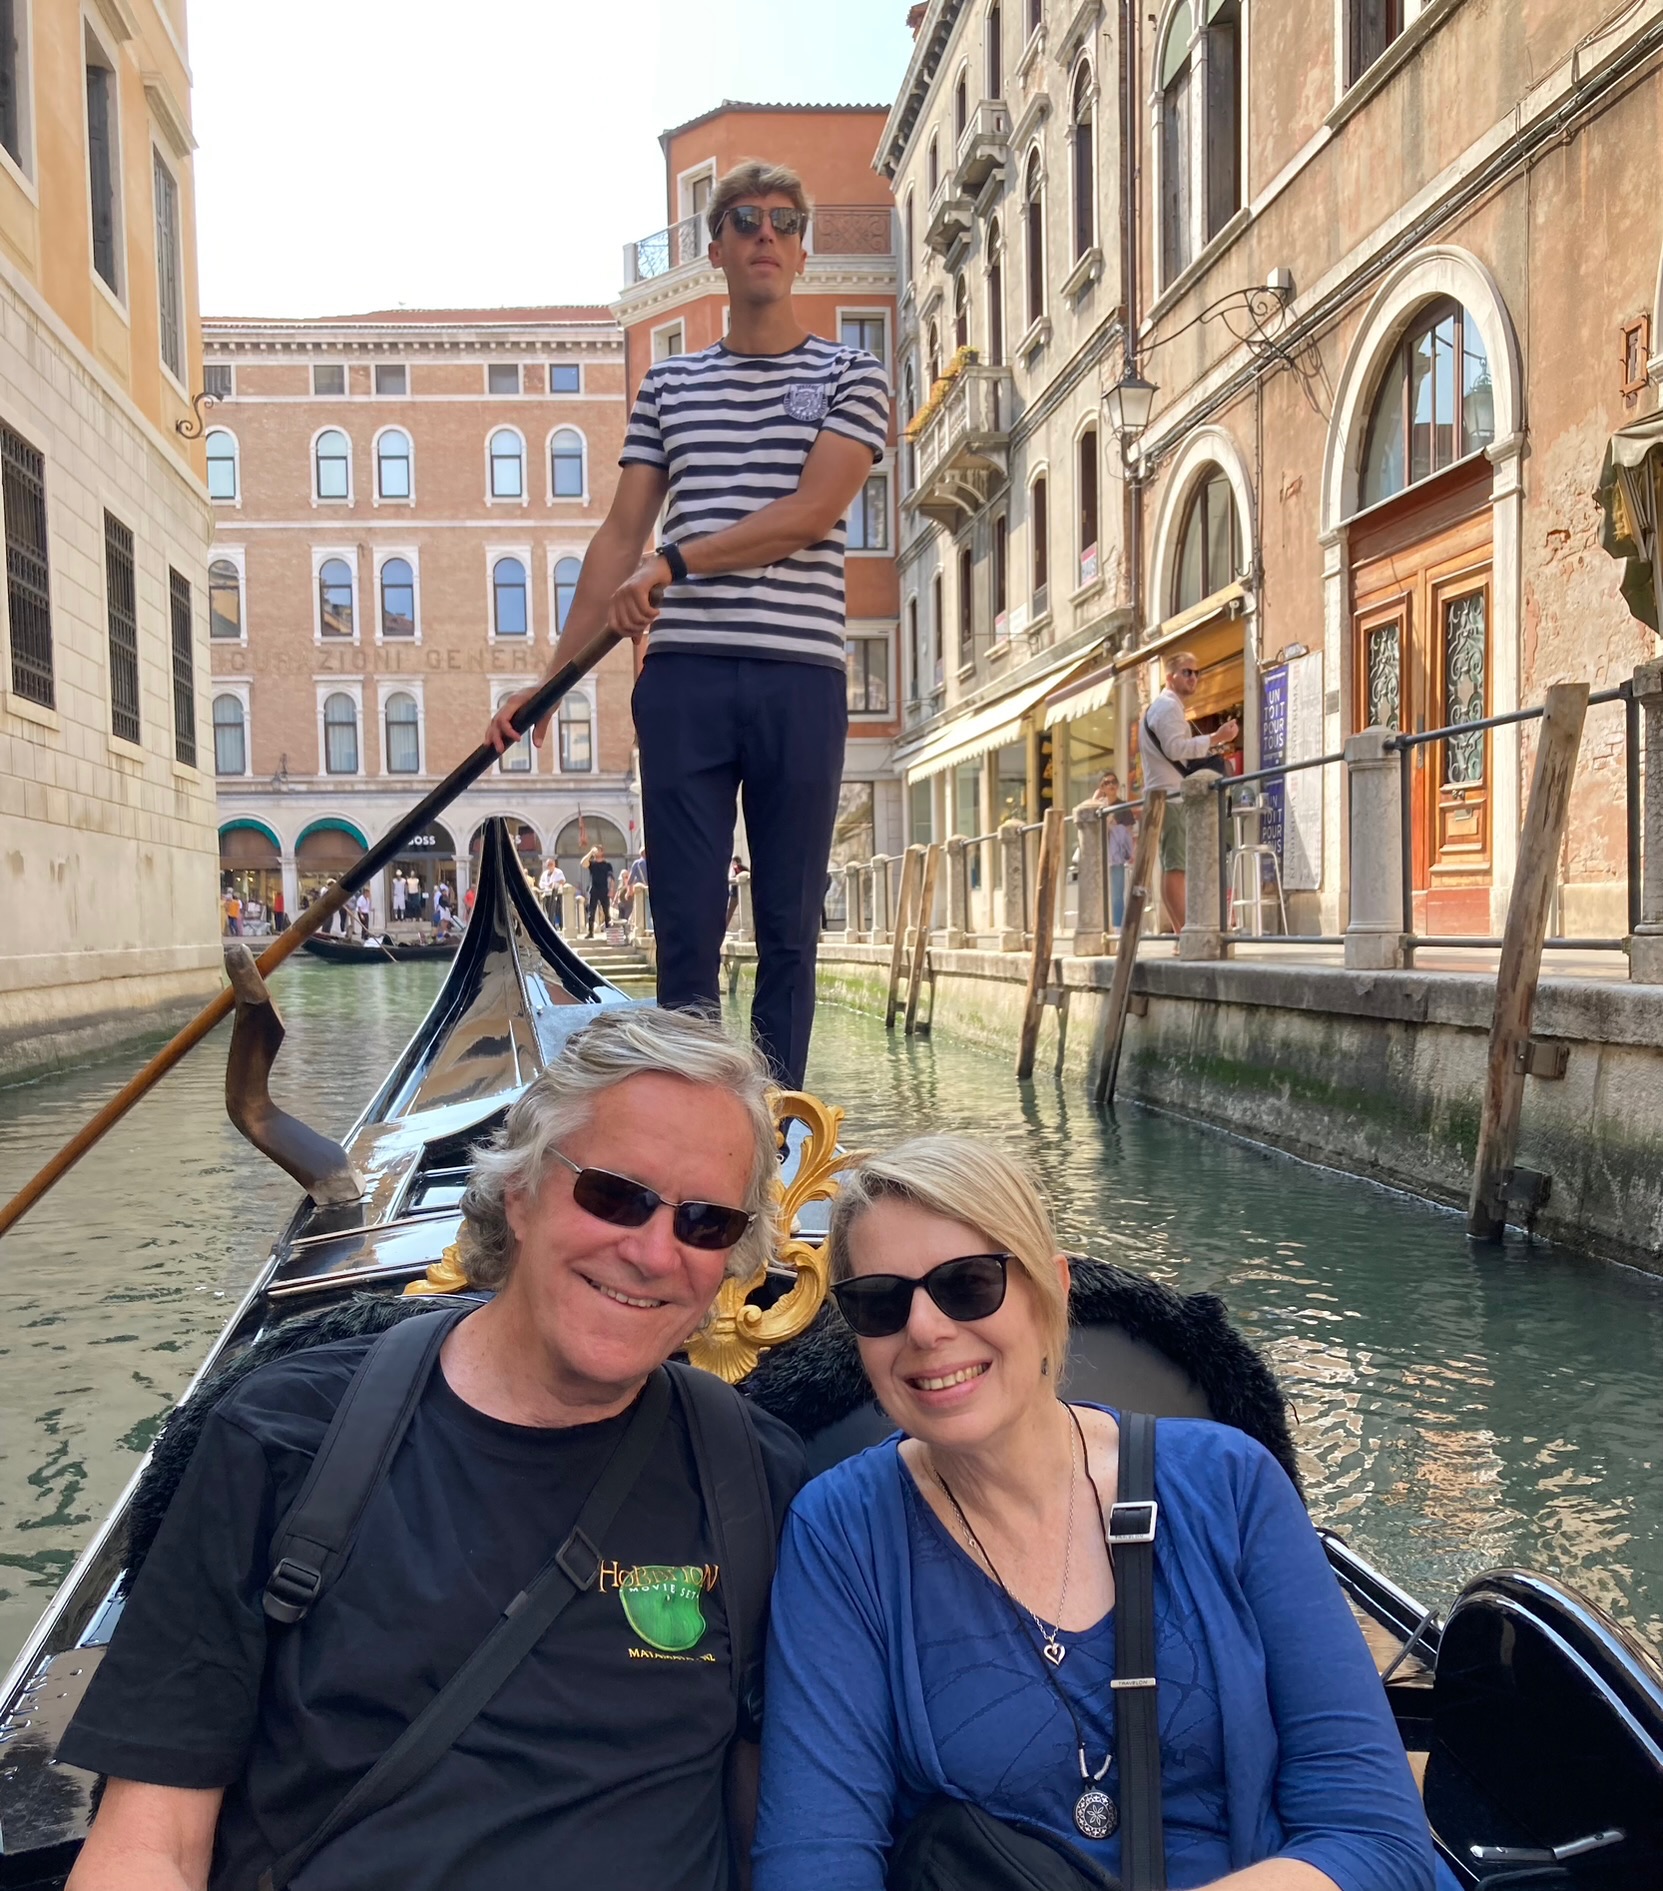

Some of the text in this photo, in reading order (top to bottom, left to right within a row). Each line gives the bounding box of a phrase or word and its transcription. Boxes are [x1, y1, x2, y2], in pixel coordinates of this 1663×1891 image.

[1268, 688, 1280, 705] UN
[1264, 701, 1285, 721] TOIT
[1263, 717, 1284, 736] POUR
[1263, 733, 1284, 751] TOUS
[1263, 823, 1283, 840] POUR
[629, 1582, 676, 1595] MOVIE
